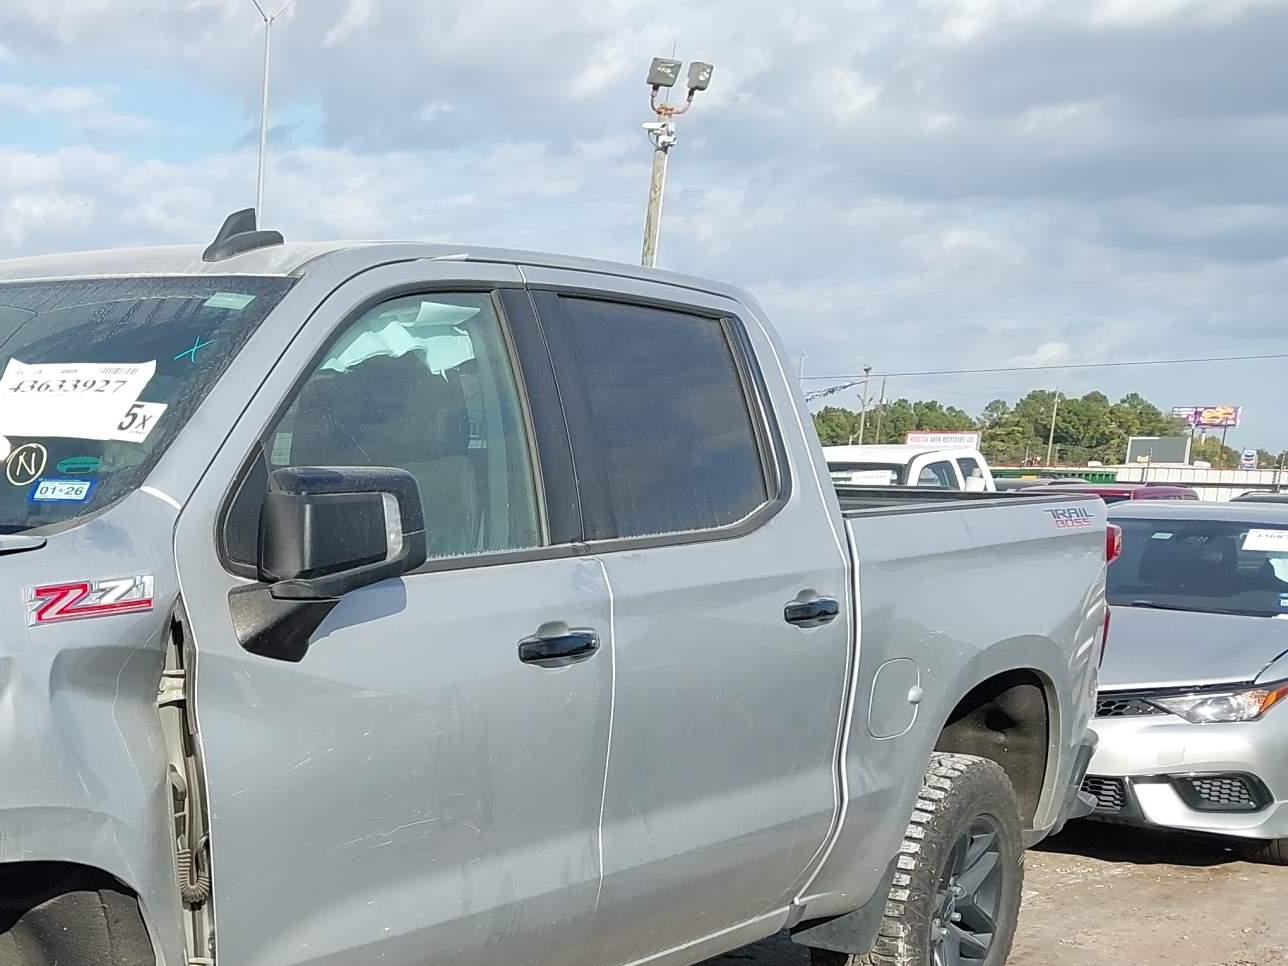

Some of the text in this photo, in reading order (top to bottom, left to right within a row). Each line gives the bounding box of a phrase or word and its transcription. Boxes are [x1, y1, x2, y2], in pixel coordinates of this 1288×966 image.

[8, 379, 128, 393] 43633927
[16, 451, 36, 476] N
[1043, 508, 1094, 519] TRAIL
[1055, 518, 1092, 528] BOSS
[26, 574, 154, 626] Z71
